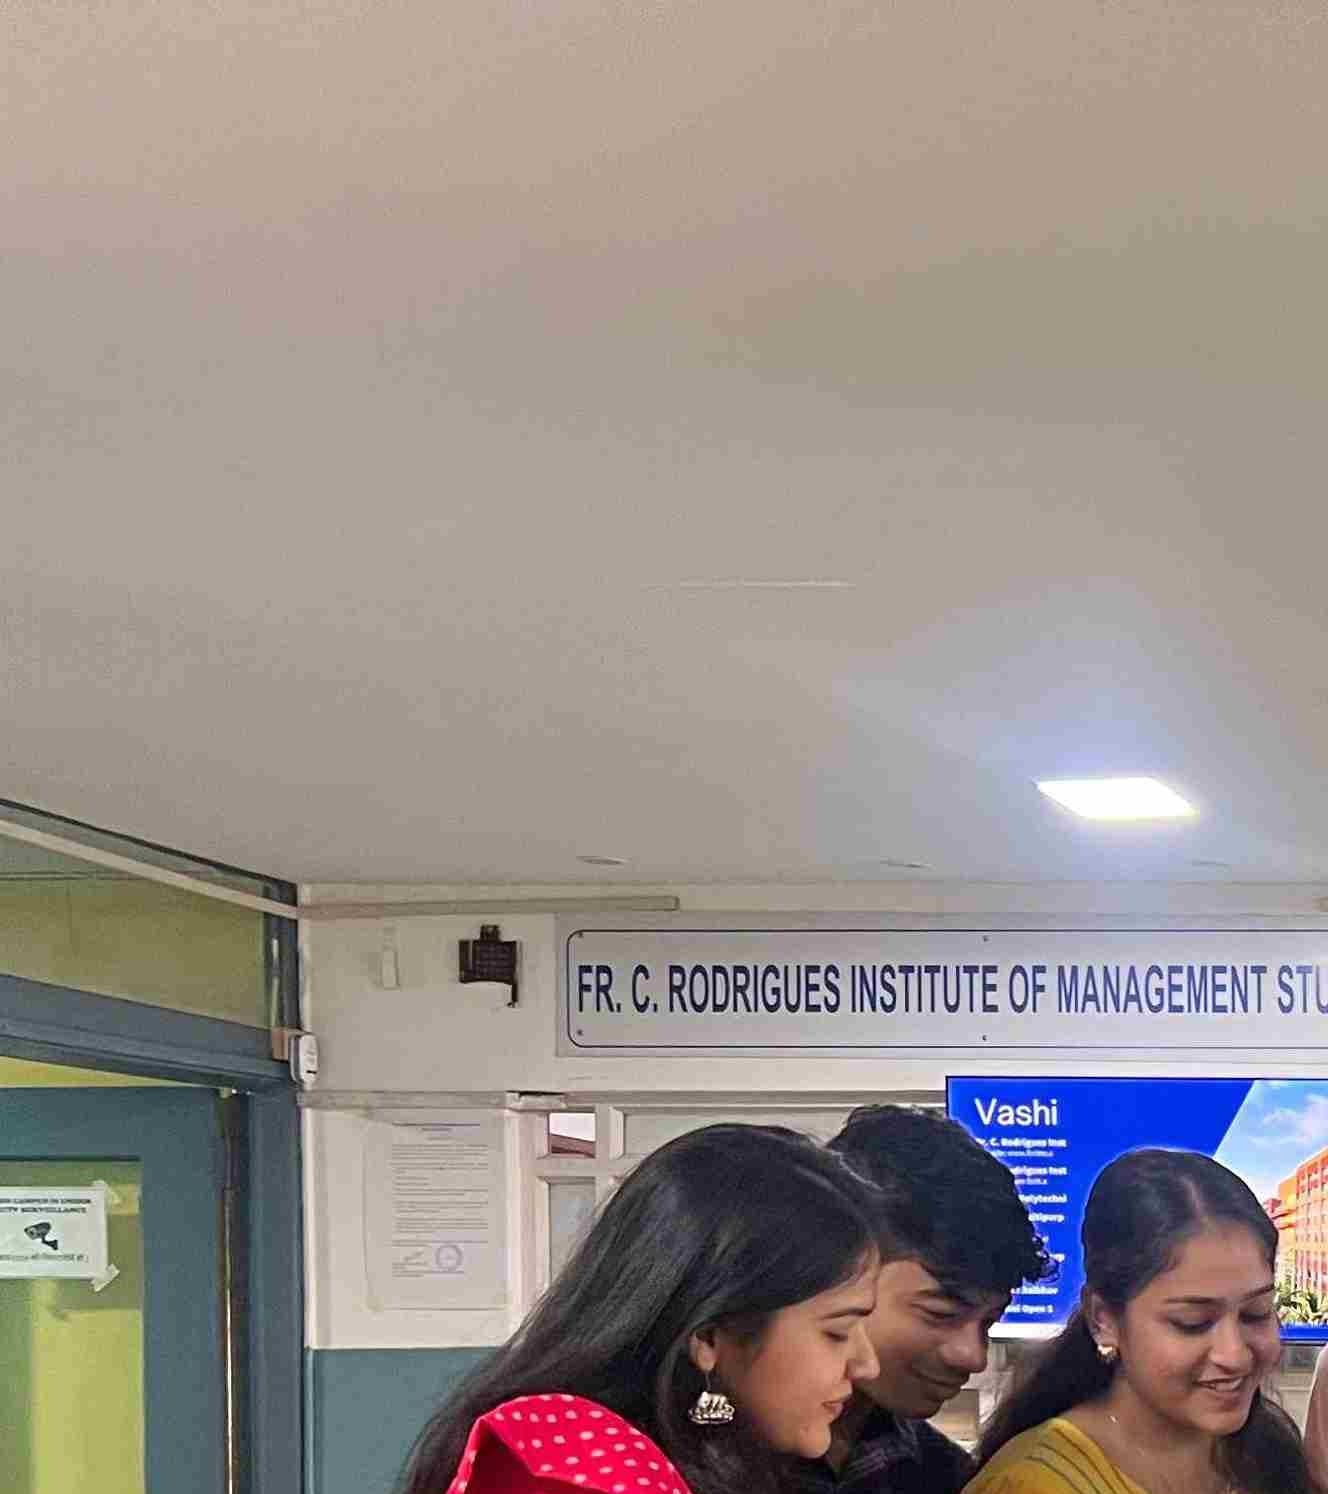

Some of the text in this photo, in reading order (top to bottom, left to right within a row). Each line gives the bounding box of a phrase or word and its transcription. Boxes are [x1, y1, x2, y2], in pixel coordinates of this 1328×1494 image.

[577, 963, 622, 1014] FR.
[631, 963, 659, 1015] C.
[668, 963, 841, 1015] RODRIGUES
[850, 963, 1000, 1015] INSTITUTE
[1008, 963, 1047, 1015] OF
[1056, 963, 1268, 1015] MANAGEMENT
[974, 1098, 1058, 1126] Vashi
